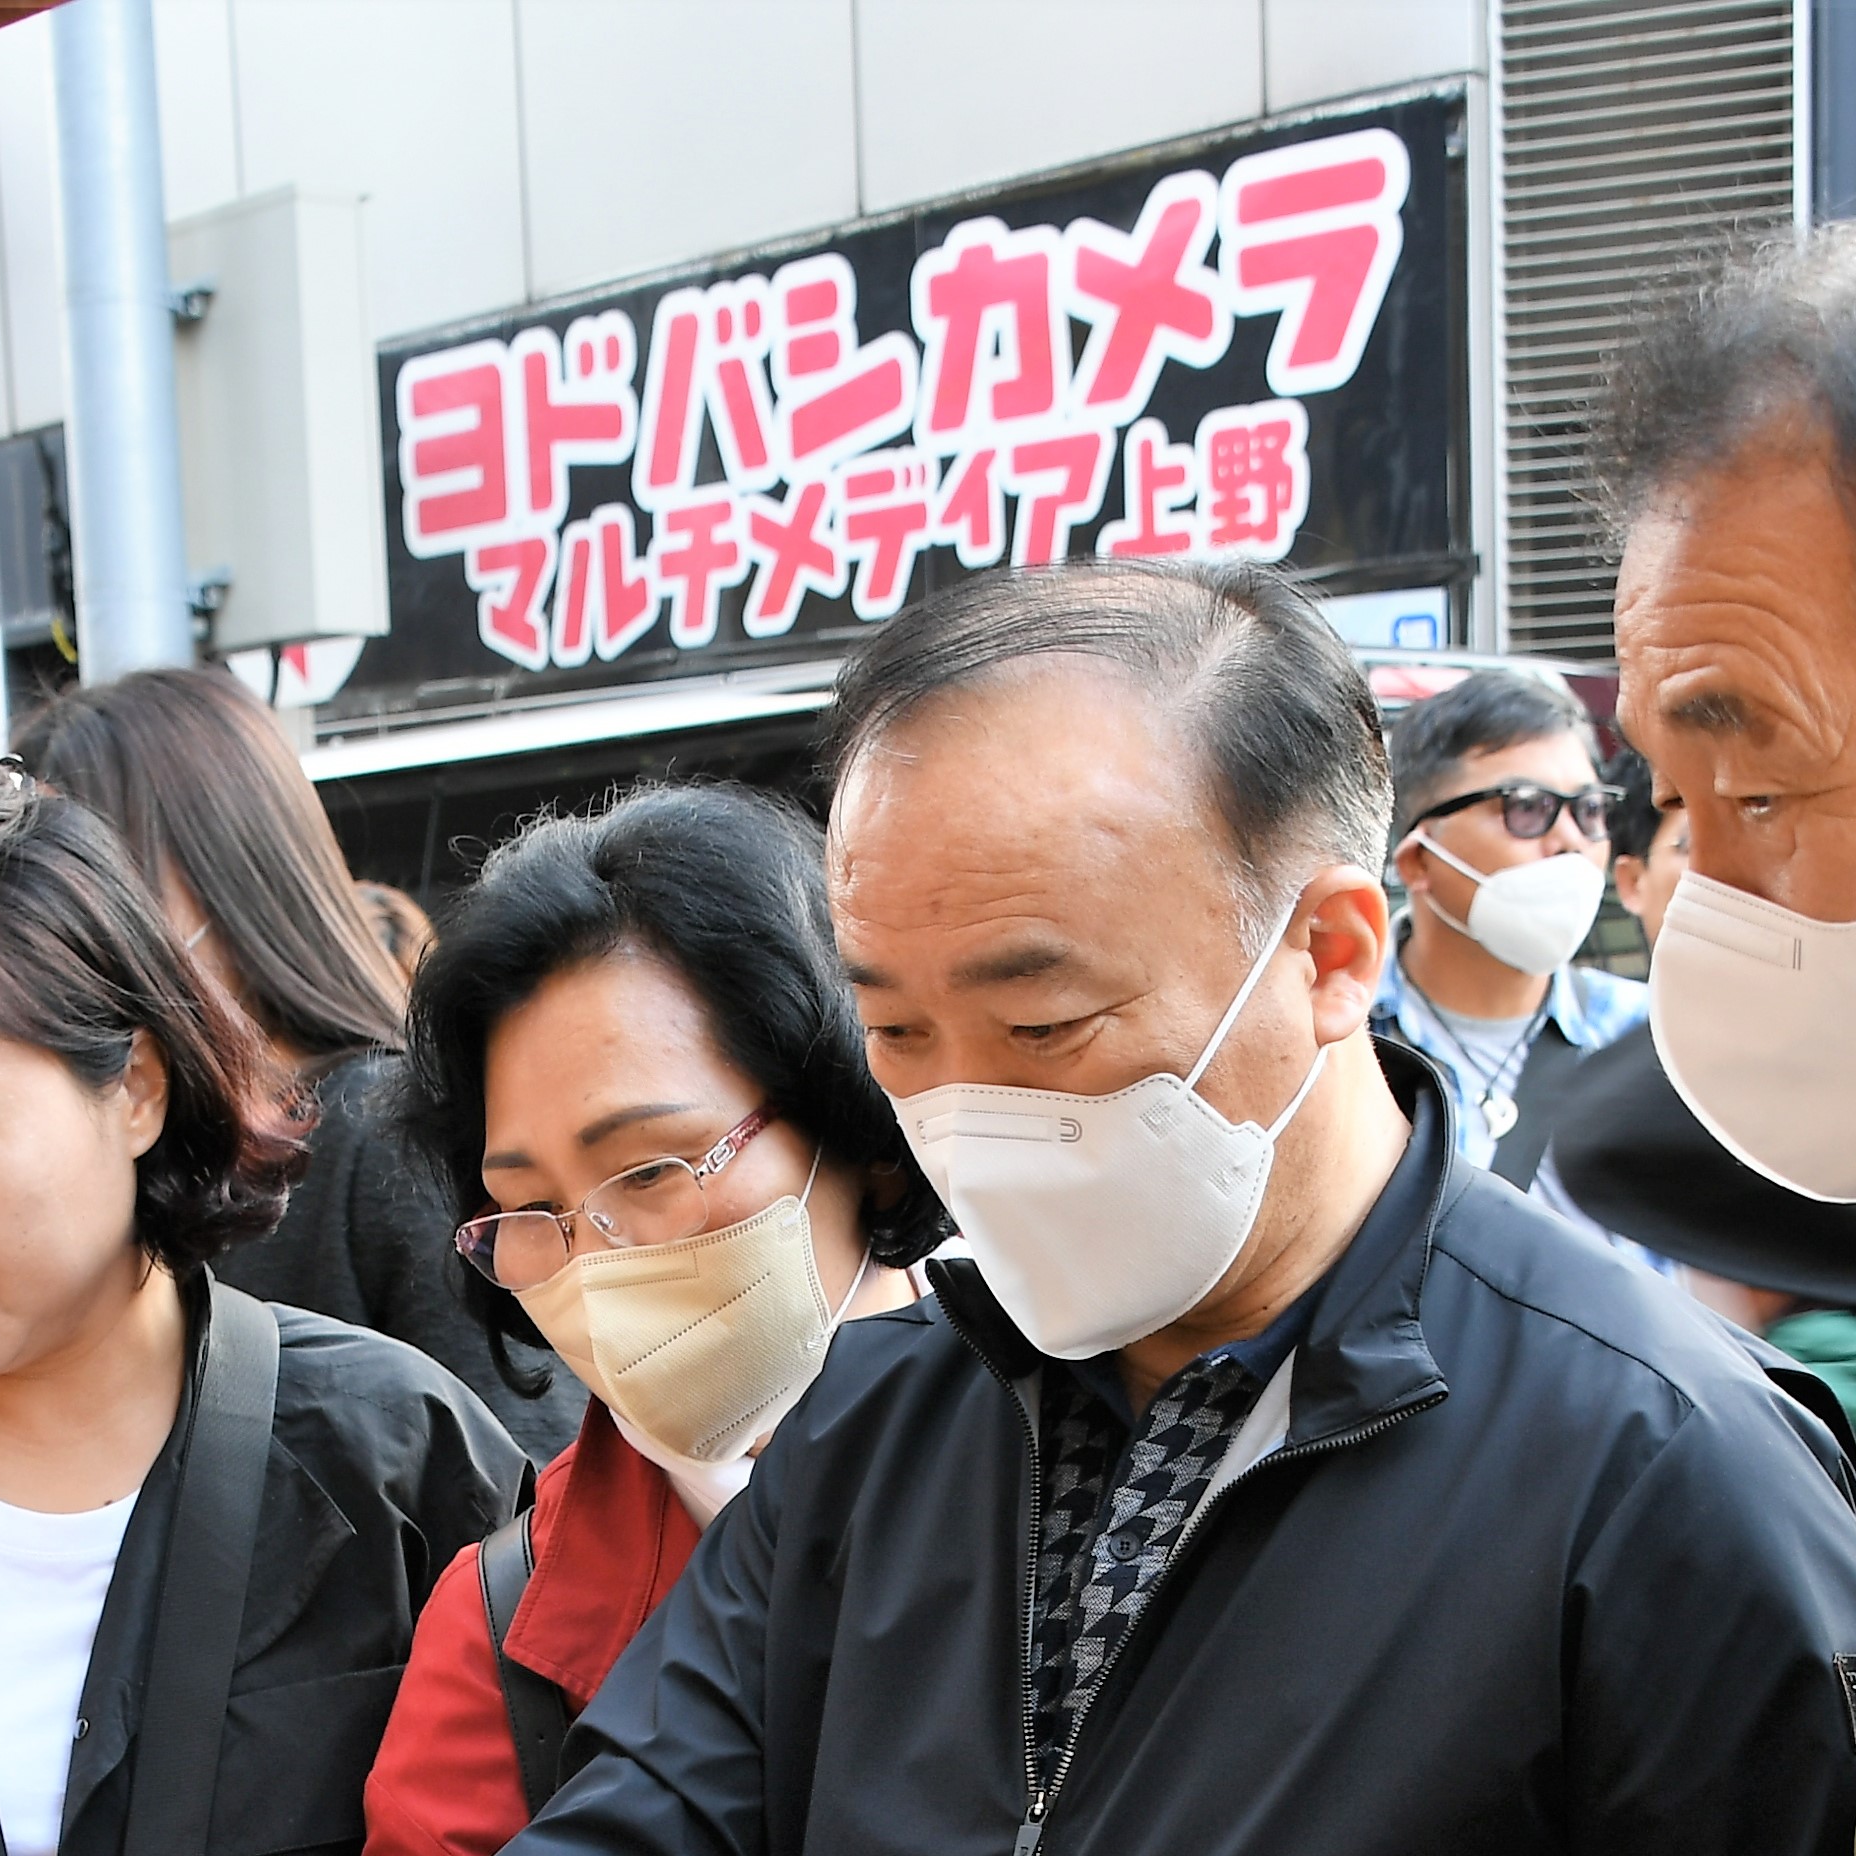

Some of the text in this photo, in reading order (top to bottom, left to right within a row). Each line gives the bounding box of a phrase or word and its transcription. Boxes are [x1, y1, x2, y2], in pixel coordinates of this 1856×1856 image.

[396, 128, 1410, 560] ヨドバシカメラ
[464, 400, 1310, 672] マルチメディア上野
